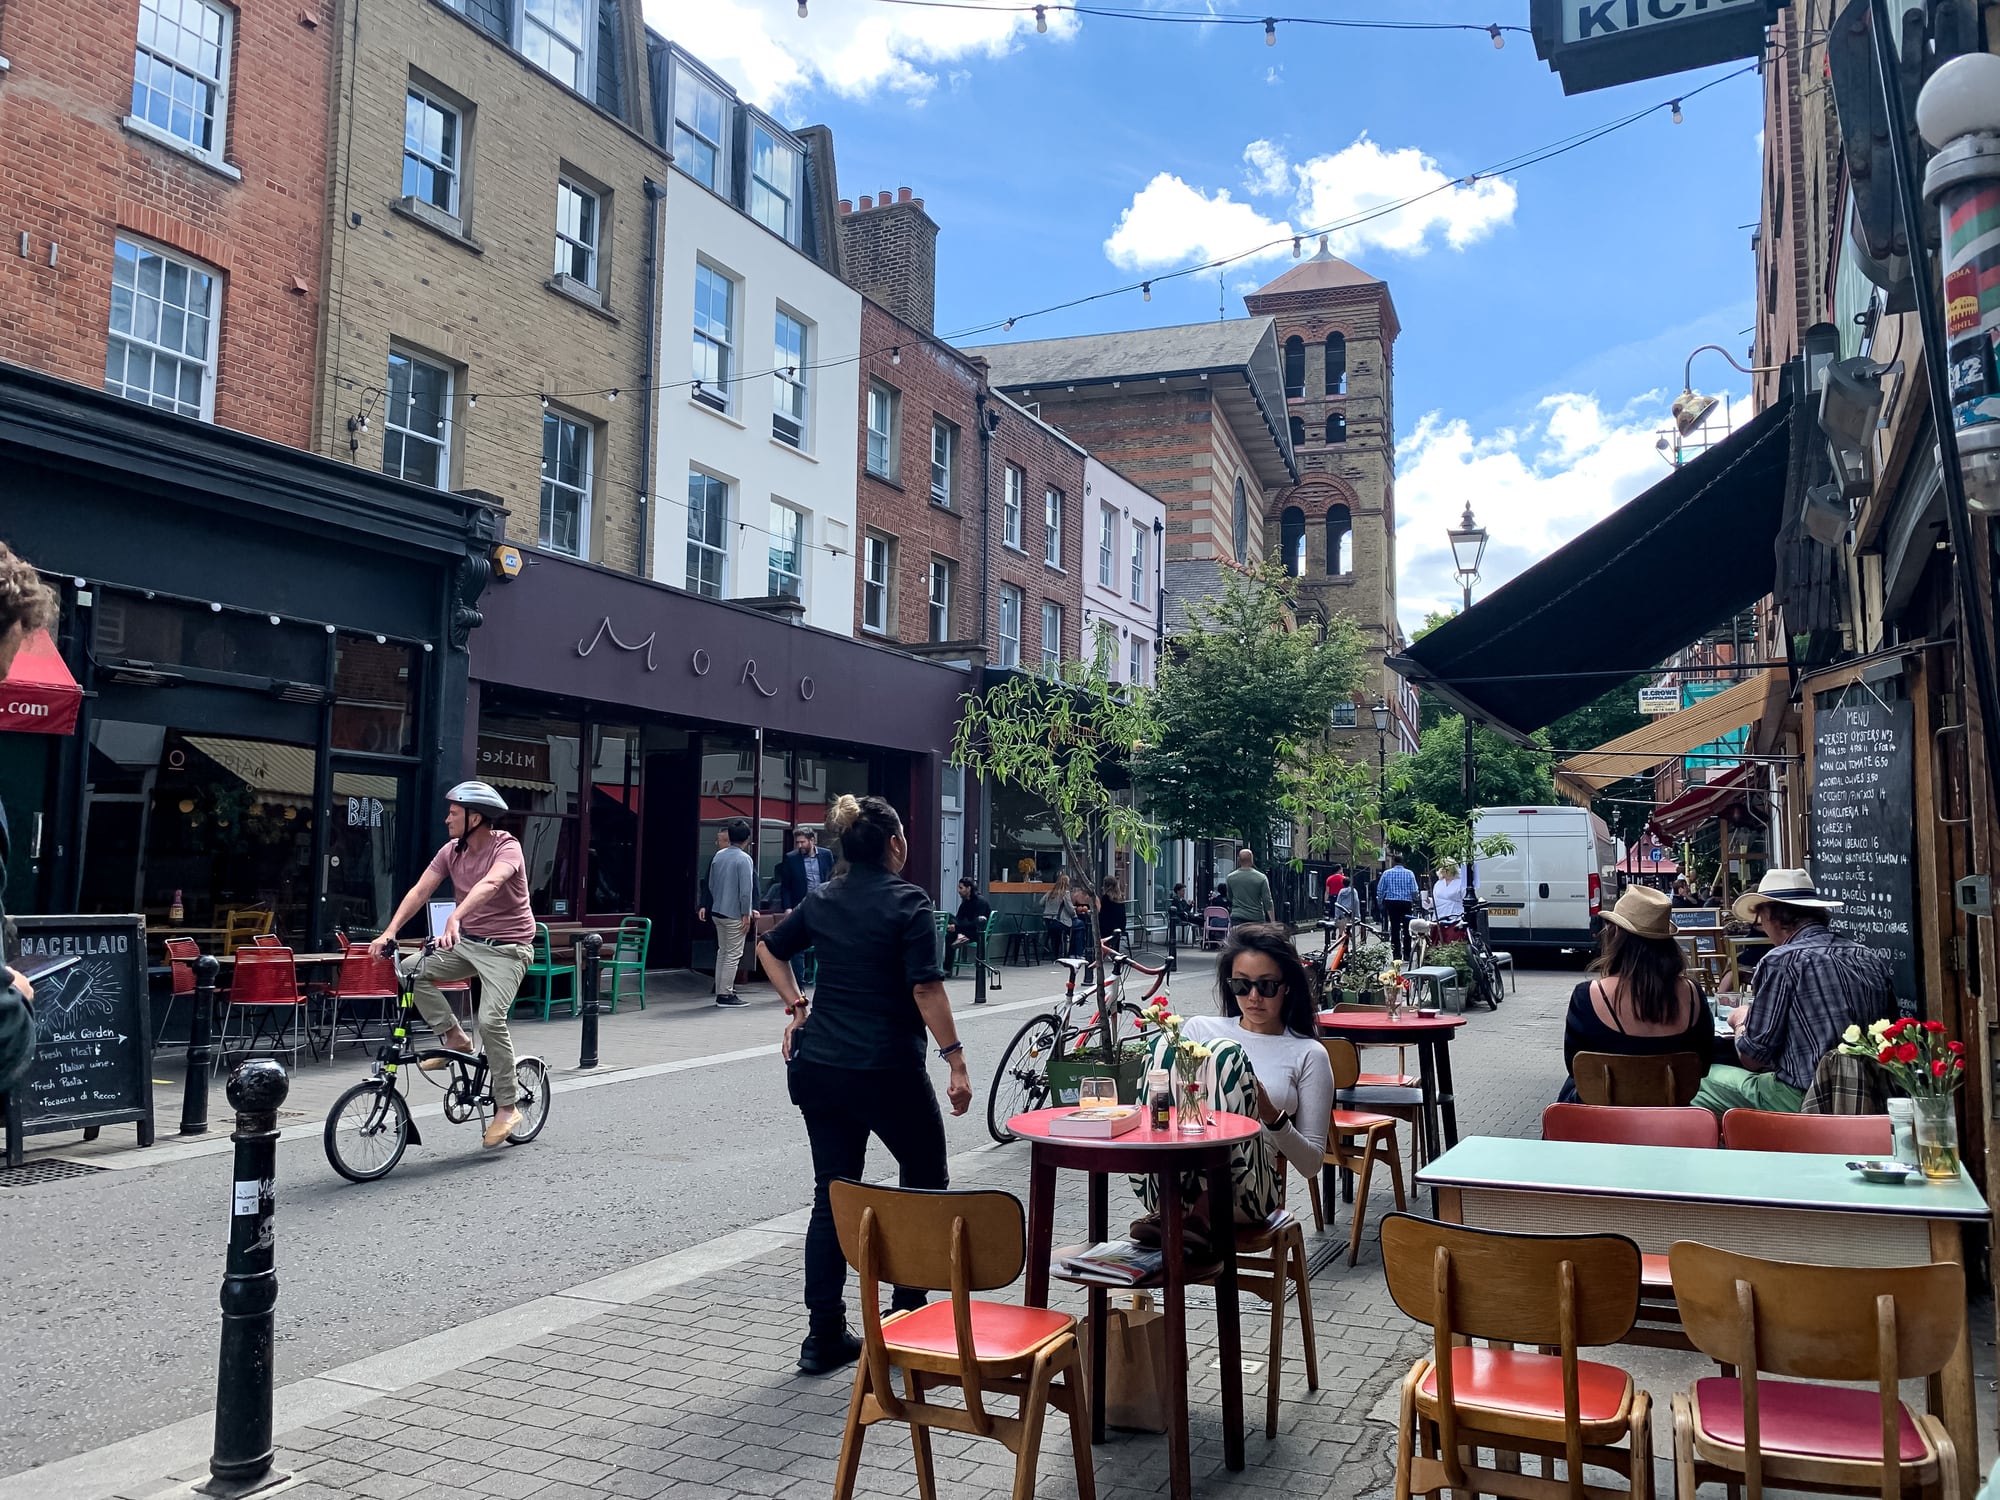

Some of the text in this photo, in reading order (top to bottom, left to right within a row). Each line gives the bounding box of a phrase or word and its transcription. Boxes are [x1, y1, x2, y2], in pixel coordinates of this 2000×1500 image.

[578, 616, 815, 700] MORO
[1846, 711, 1870, 727] MENU
[1824, 732, 1848, 746] JERSEY
[1850, 729, 1879, 743] OYSTERS
[1824, 761, 1834, 771] PAN
[1835, 760, 1847, 771] CON
[1848, 755, 1873, 770] TOMATE
[348, 797, 384, 827] BAR
[1822, 822, 1844, 834] CHEESE
[1875, 852, 1898, 865] SALMON
[1841, 888, 1867, 902] BAGELS
[20, 935, 128, 957] MACELLAIO
[53, 1026, 114, 1042] Back Garden
[39, 1045, 93, 1061] Fresh Meat
[59, 1060, 109, 1074] Italian wine
[34, 1077, 83, 1092] Fresh Pasta
[43, 1090, 117, 1107] Focaccia di Recco
